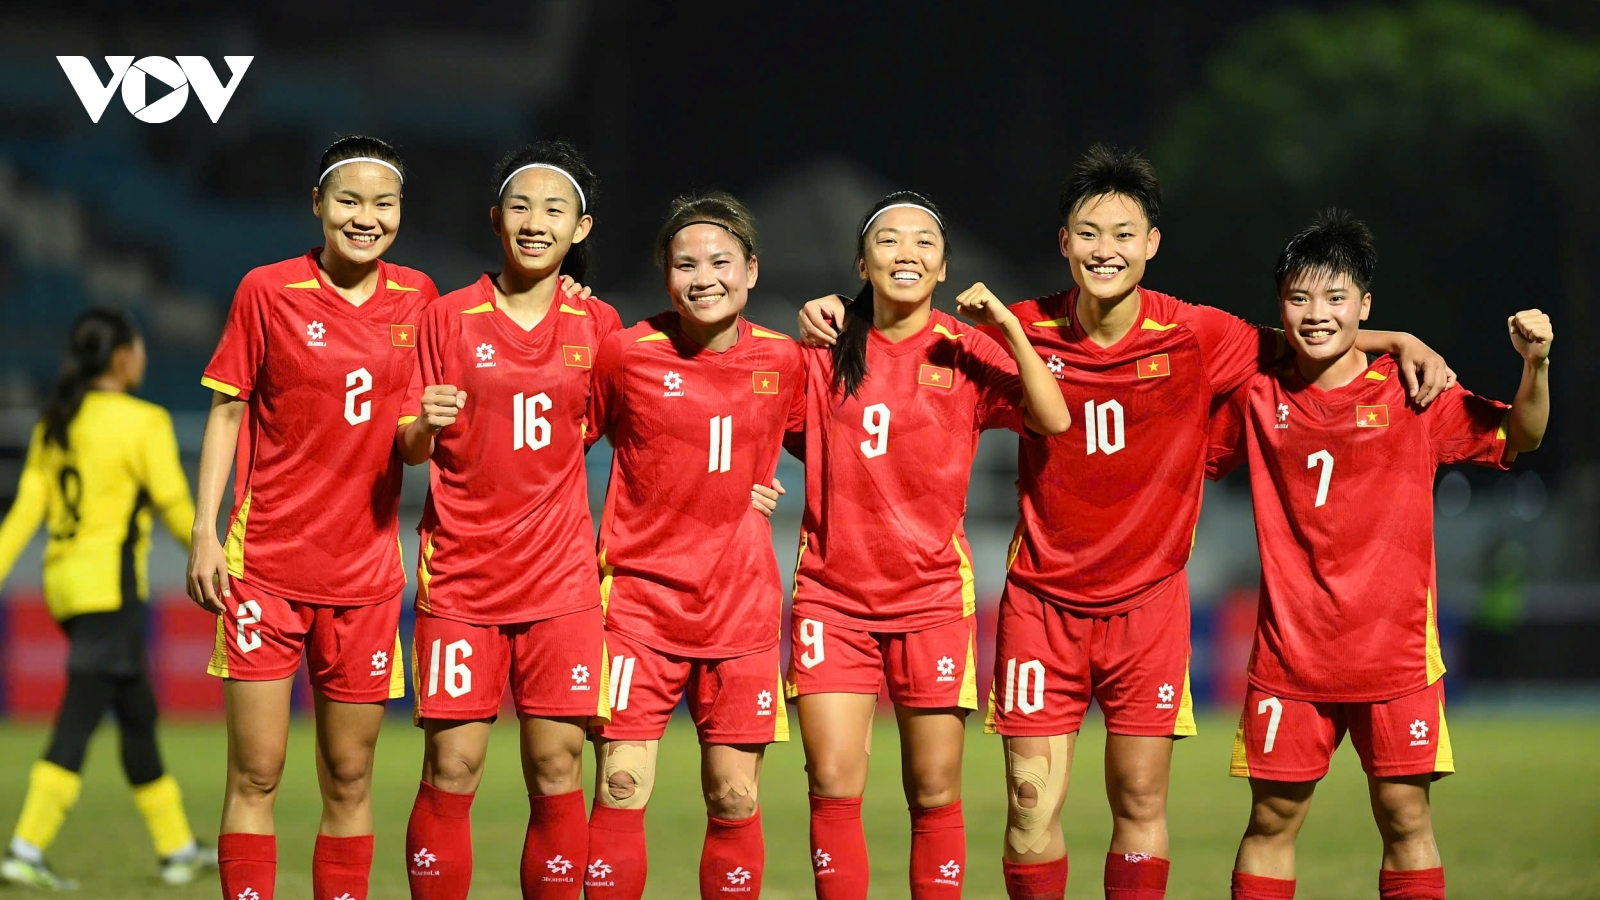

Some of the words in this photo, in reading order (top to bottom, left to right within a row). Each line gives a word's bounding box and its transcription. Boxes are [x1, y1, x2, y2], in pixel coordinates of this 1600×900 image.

[344, 368, 373, 426] 2
[512, 391, 553, 451] 16
[707, 414, 733, 474] 11
[860, 402, 891, 459] 9
[1084, 398, 1127, 456] 10
[1307, 449, 1334, 508] 7
[236, 599, 263, 654] 2
[799, 618, 825, 670] 9
[427, 638, 473, 699] 16
[608, 654, 636, 712] 11
[1003, 657, 1046, 715] 10
[1257, 696, 1283, 754] 7
